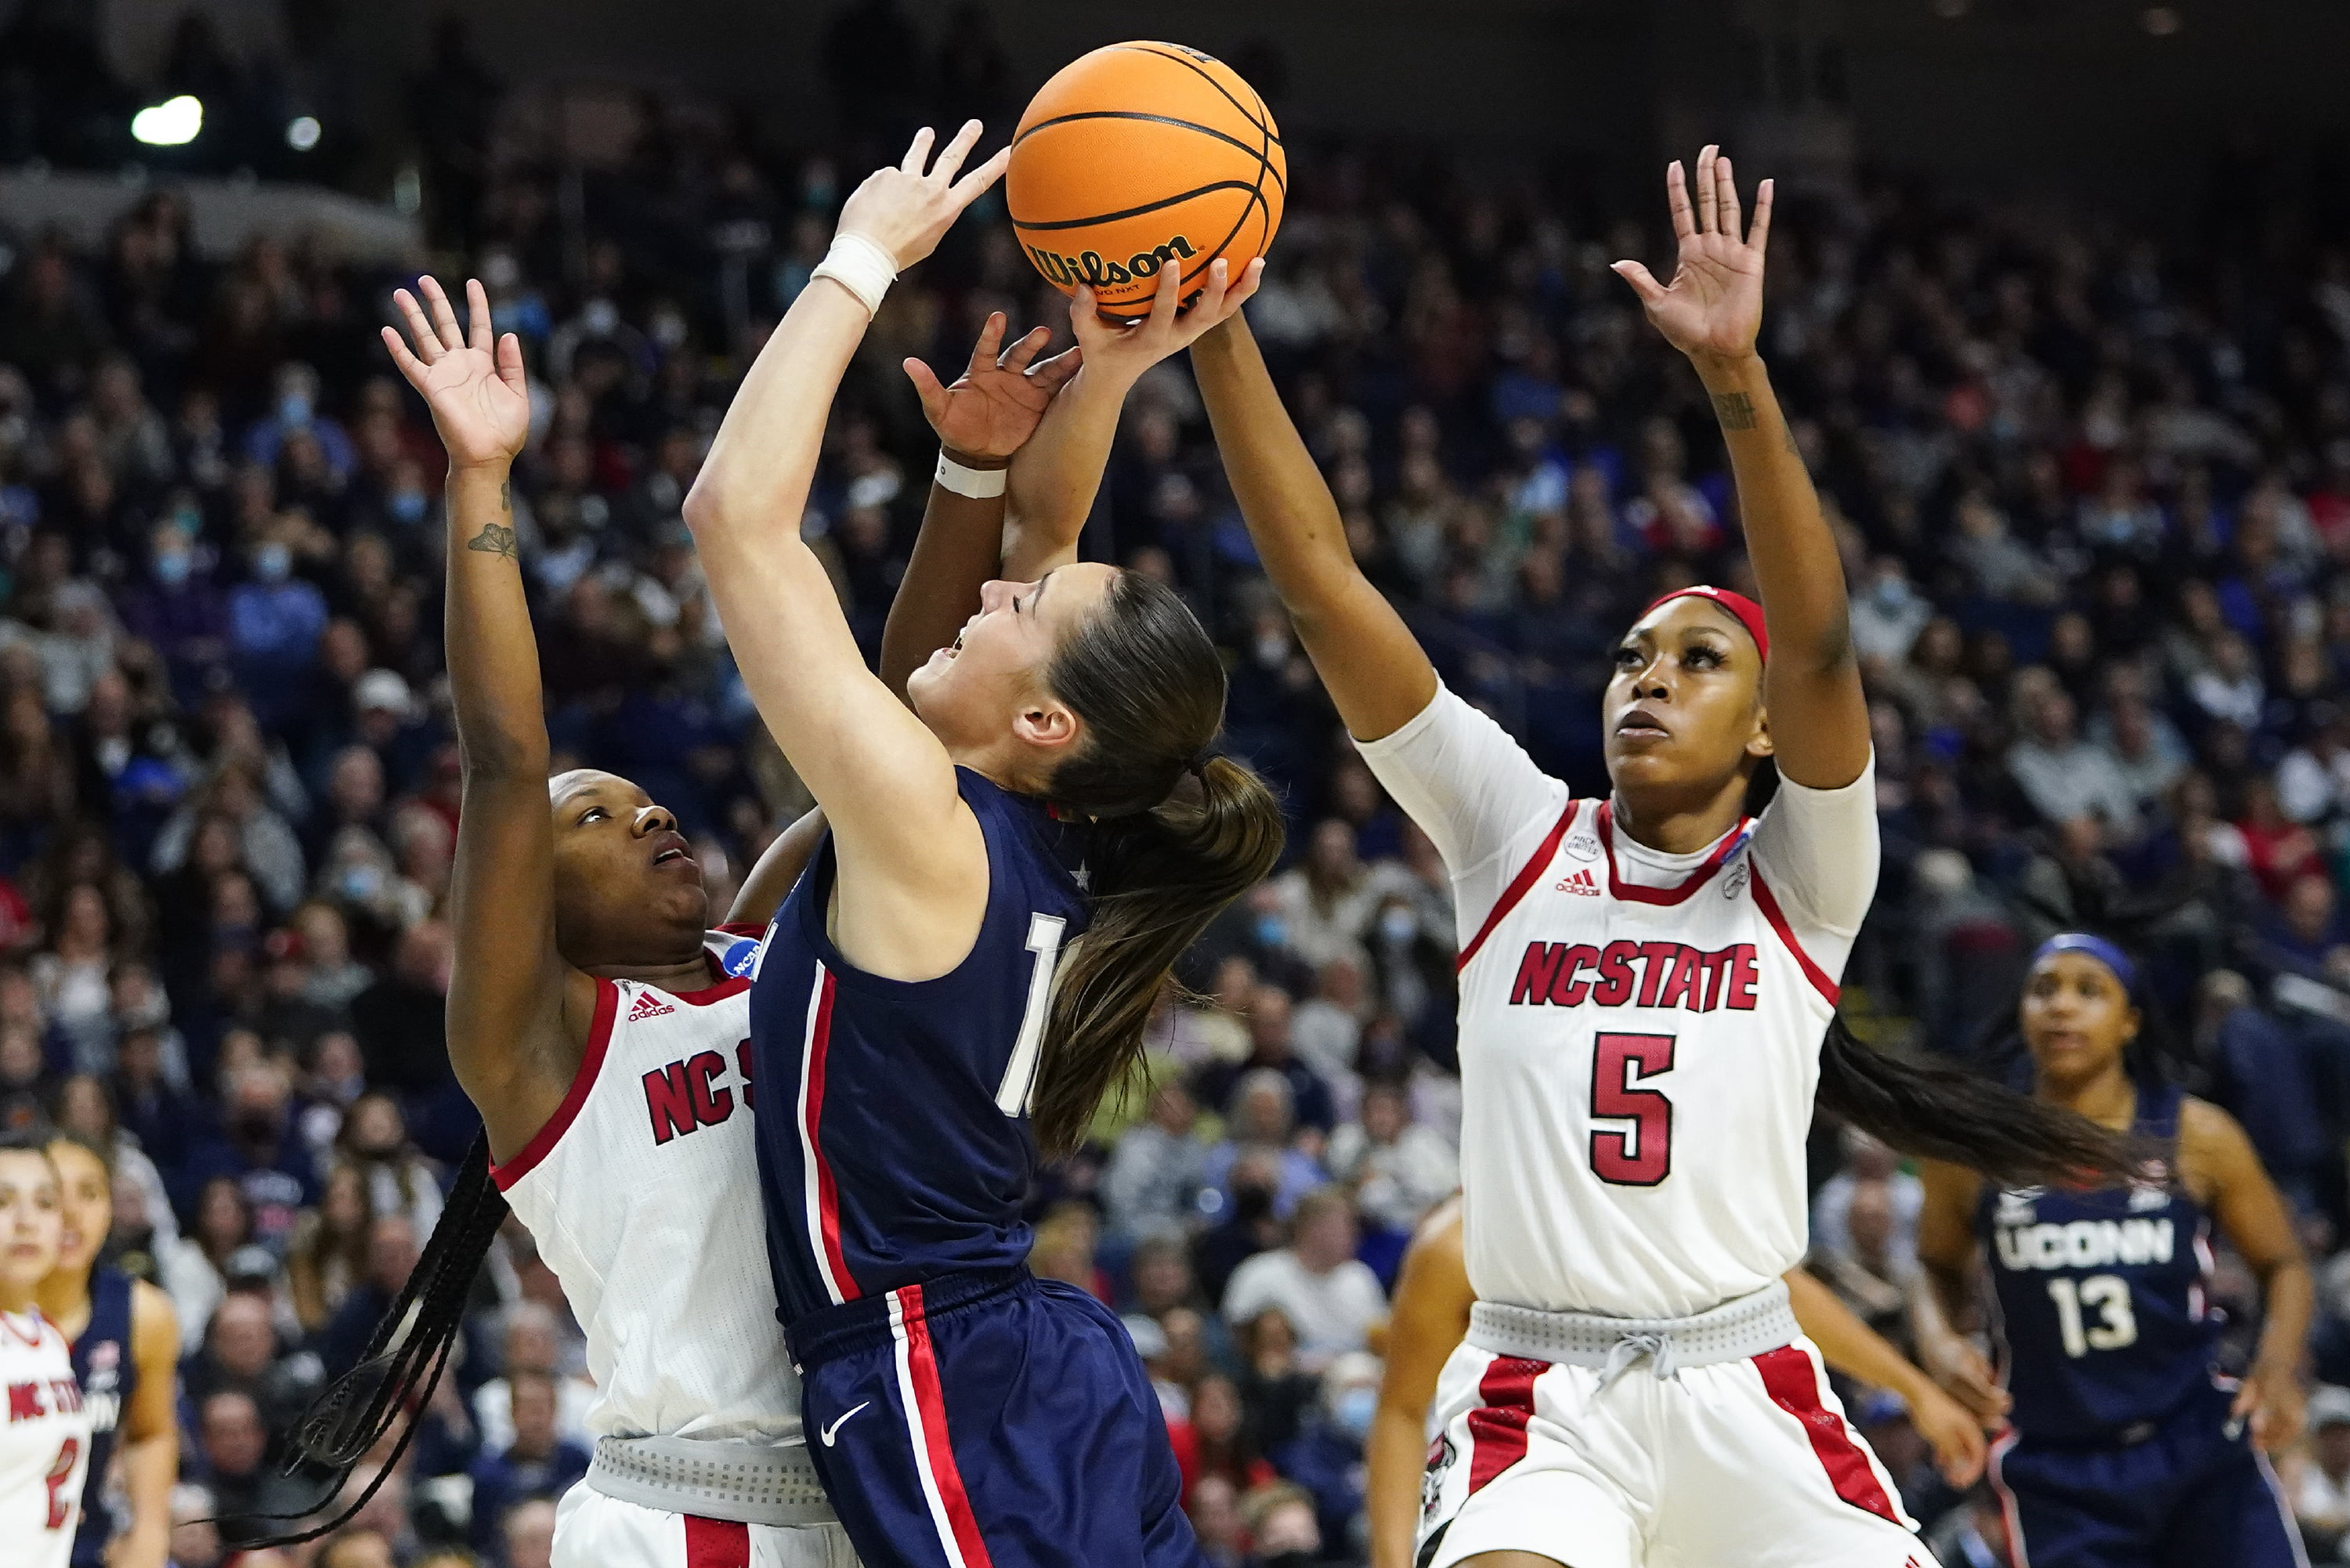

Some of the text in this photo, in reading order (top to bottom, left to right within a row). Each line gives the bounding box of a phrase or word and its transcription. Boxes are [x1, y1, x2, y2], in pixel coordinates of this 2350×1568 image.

[1027, 234, 1198, 288] Wilson
[1115, 284, 1141, 294] NXT
[1556, 883, 1600, 897] adidas
[628, 1005, 675, 1022] adidas
[642, 1050, 733, 1146] NC
[1589, 1031, 1677, 1187] 5
[1994, 1217, 2175, 1270] UCONN
[2046, 1274, 2138, 1359] 13
[46, 1438, 78, 1530] 2
